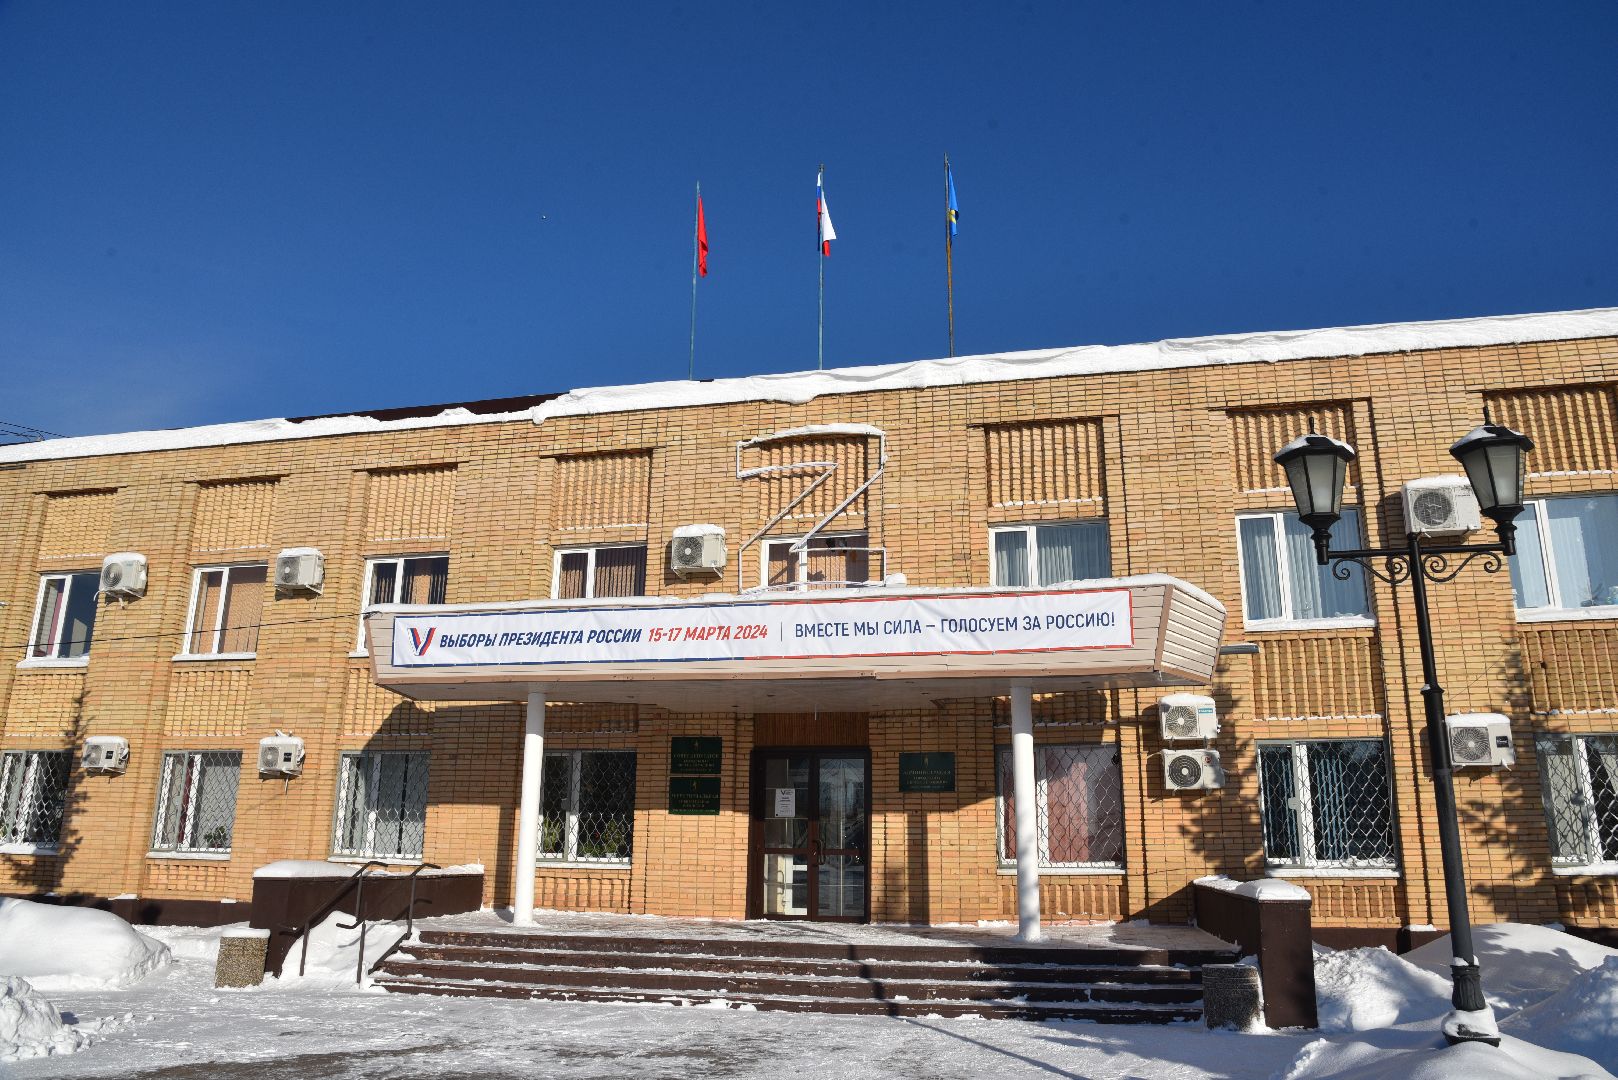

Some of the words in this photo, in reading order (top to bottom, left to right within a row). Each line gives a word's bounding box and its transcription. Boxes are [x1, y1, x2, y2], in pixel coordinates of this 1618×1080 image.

[439, 633, 498, 649] ВЫБОРЫ
[498, 630, 584, 647] ПРЕЗИДЕНТА
[586, 628, 643, 644] РОССИИ
[647, 627, 683, 642] 15-17
[683, 625, 731, 642] МАРТА
[733, 624, 769, 640] 2024
[794, 622, 850, 638] ВМЕСТЕ
[853, 621, 880, 637] МЫ
[883, 619, 922, 635] СИЛА
[940, 616, 1018, 634] ГОЛОСУЕМ
[1022, 615, 1042, 631] ЗА
[1046, 611, 1116, 630] РОССИЮ!
